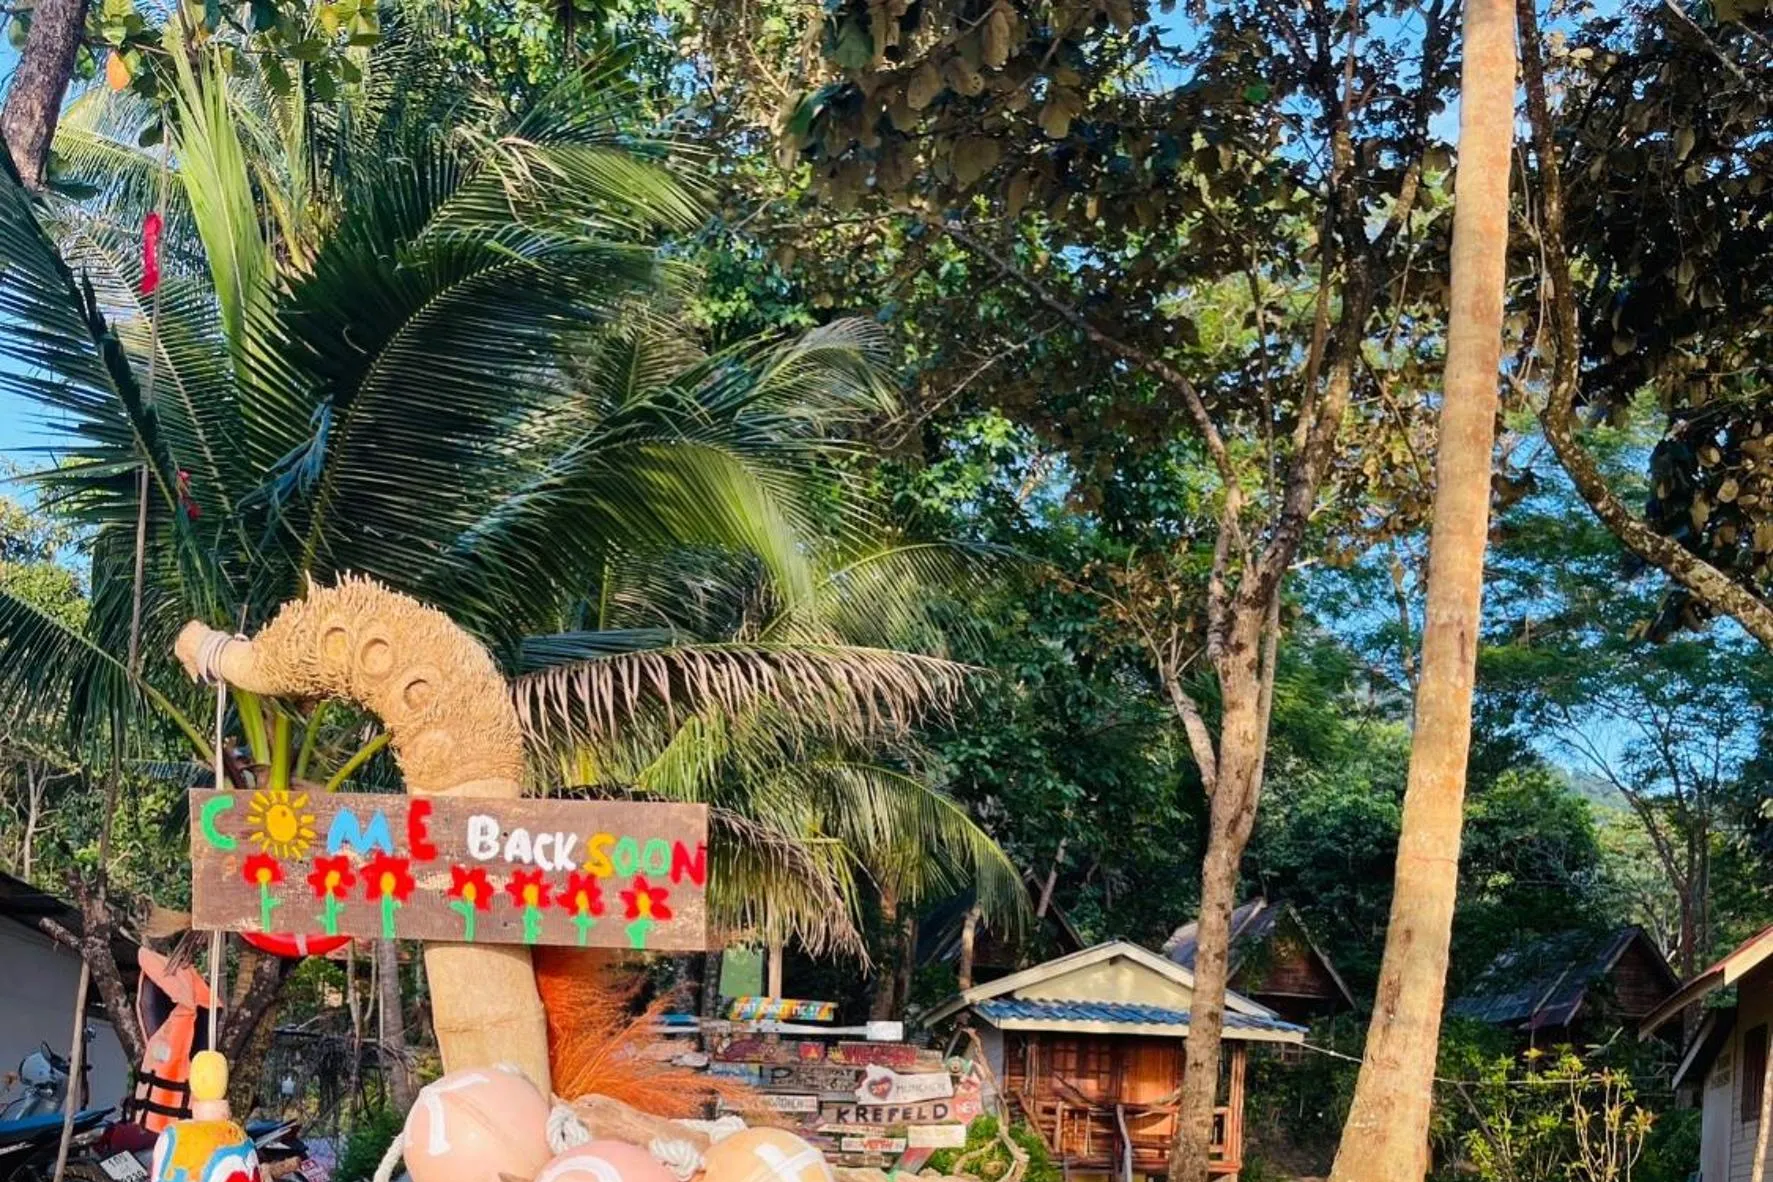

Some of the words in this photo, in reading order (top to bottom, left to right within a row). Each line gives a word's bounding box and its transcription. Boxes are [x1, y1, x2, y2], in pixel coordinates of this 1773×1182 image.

[466, 813, 578, 873] BACK
[583, 832, 708, 887] SOON
[836, 1102, 949, 1124] KREFELD
